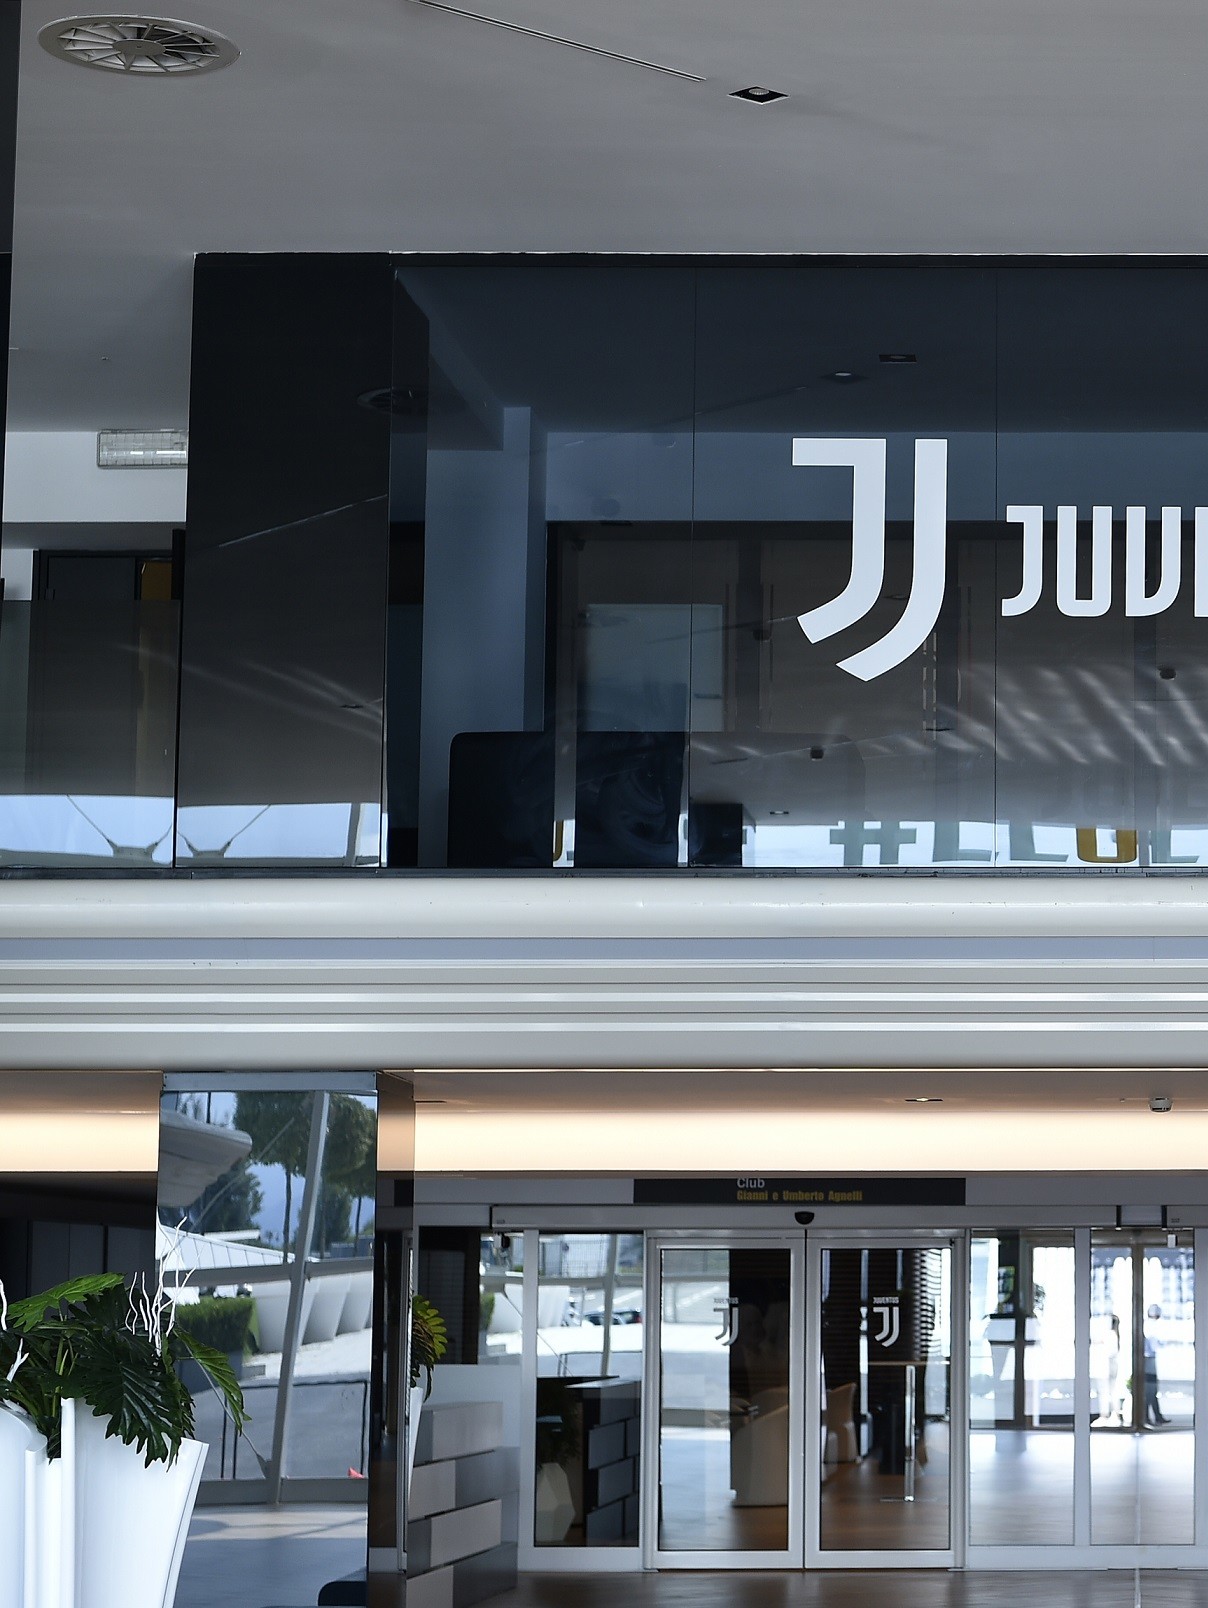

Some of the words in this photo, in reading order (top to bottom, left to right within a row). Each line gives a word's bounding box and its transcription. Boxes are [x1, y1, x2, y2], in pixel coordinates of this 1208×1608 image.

[737, 1177, 765, 1189] Club
[737, 1190, 768, 1201] Gianni
[772, 1192, 779, 1201] e
[782, 1190, 825, 1201] Umberto
[828, 1190, 863, 1203] Agnelli
